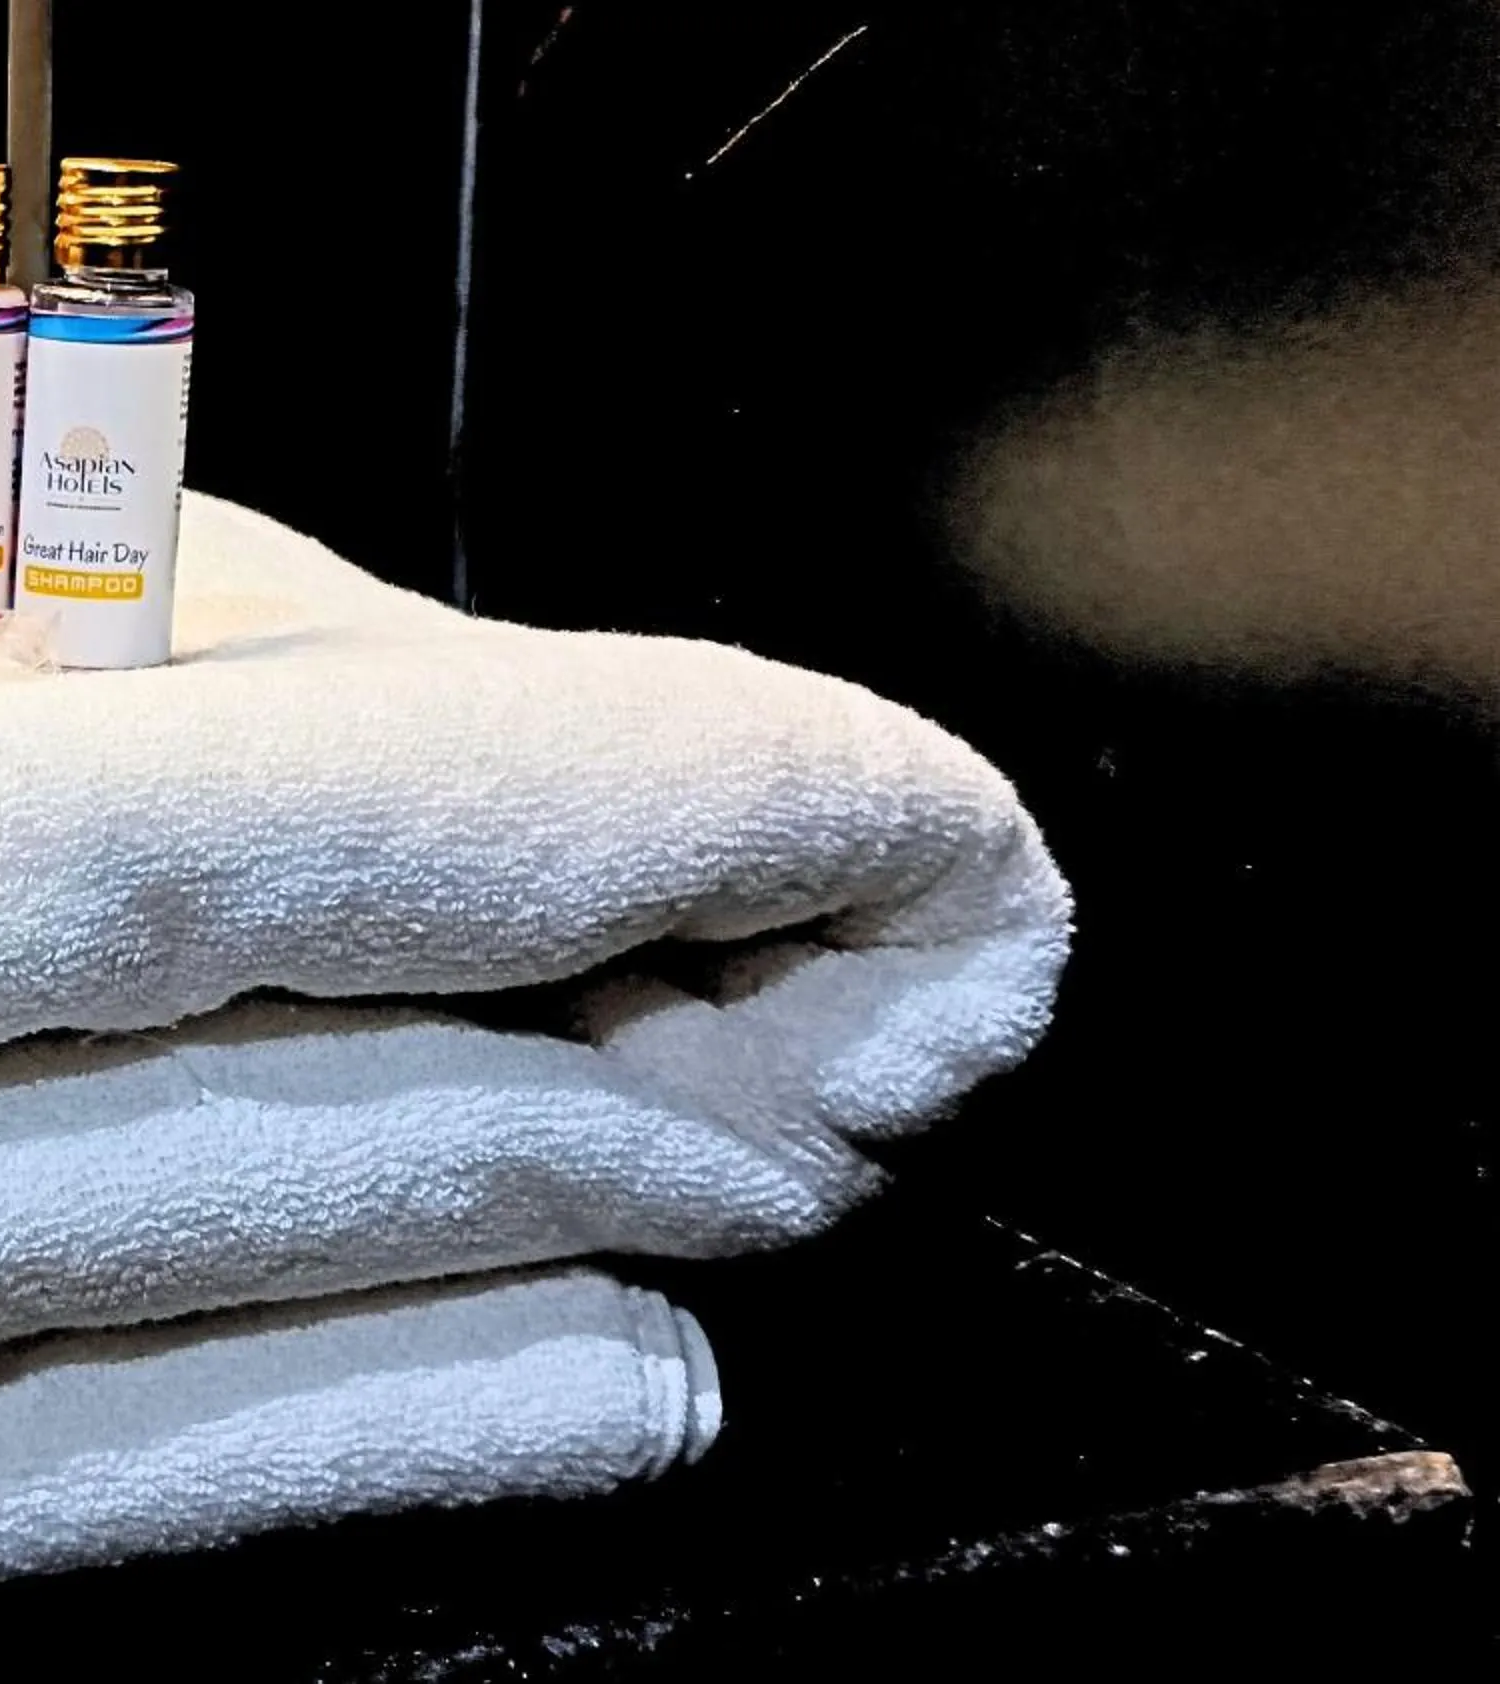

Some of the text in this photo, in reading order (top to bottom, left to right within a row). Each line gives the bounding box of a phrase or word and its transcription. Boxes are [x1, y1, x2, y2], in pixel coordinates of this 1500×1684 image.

[40, 451, 136, 475] Asapian
[23, 534, 149, 573] Great Hair Day
[28, 568, 137, 593] SHAMPOO
